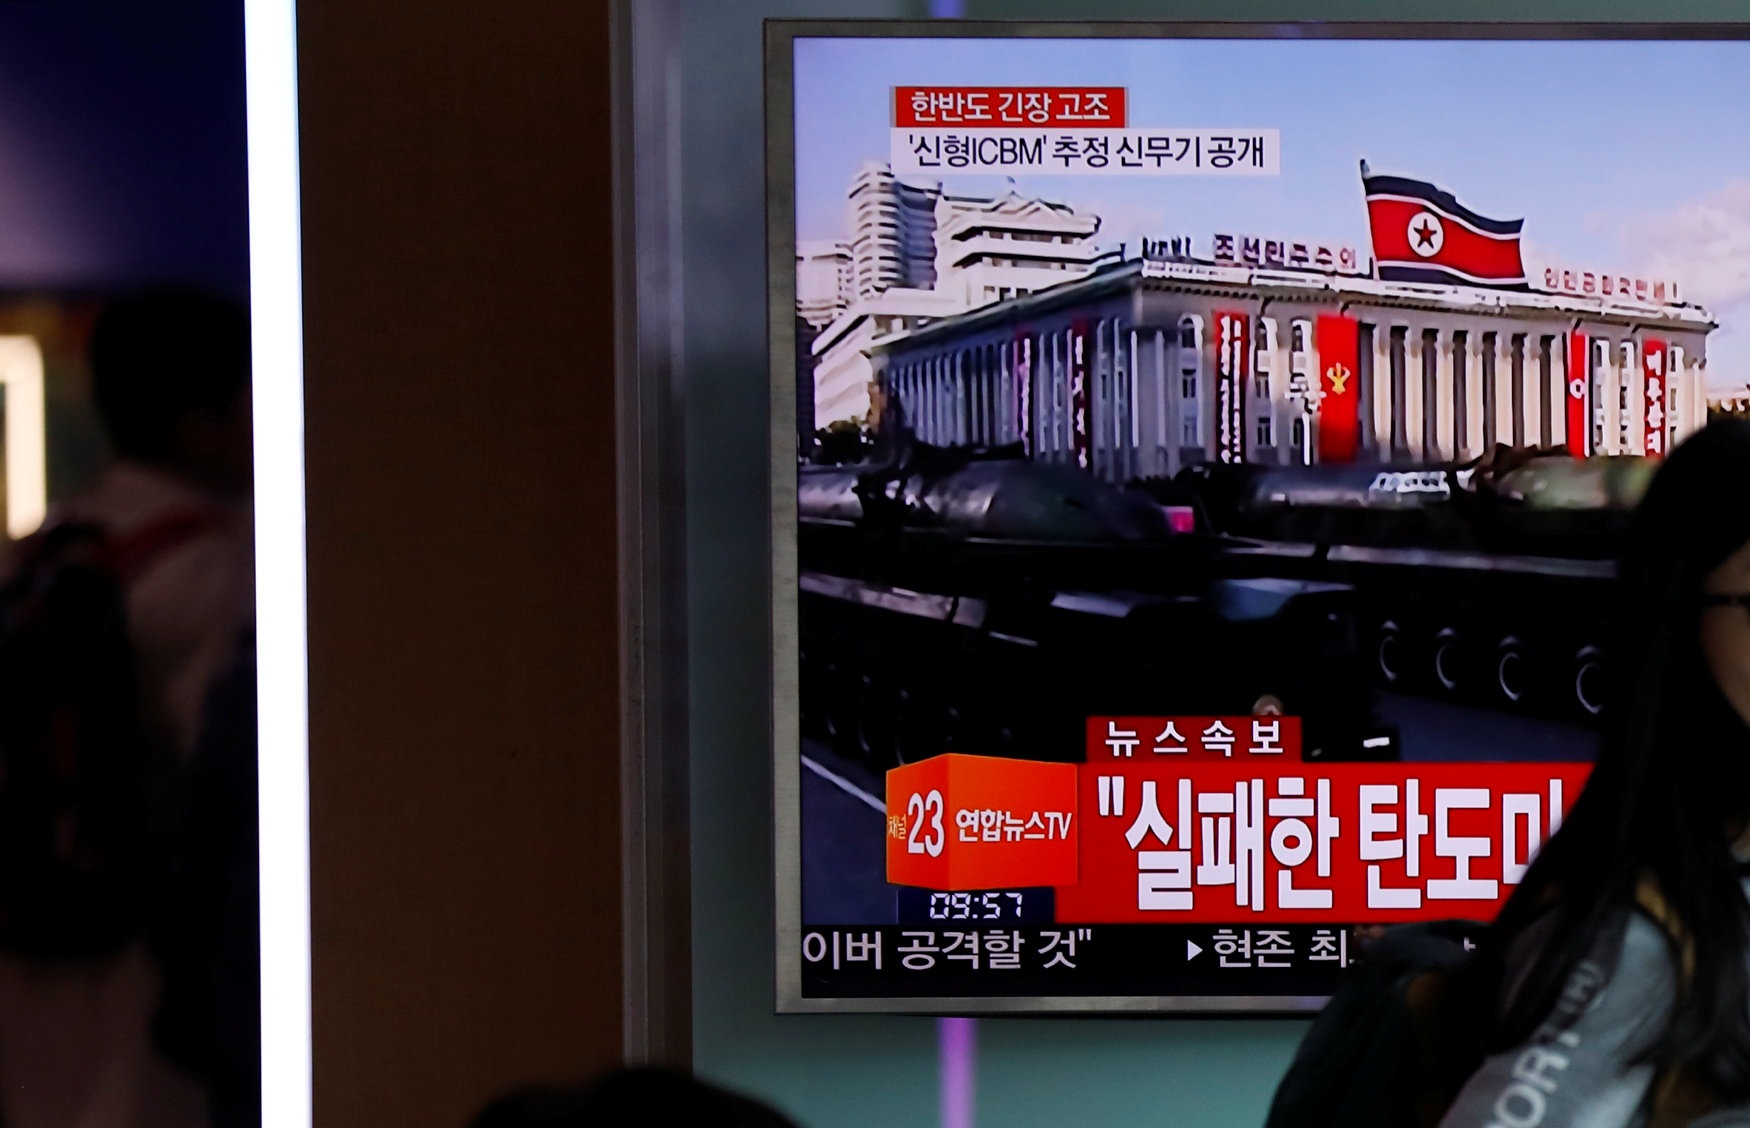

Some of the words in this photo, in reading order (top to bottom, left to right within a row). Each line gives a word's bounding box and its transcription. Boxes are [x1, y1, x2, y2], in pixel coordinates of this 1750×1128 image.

[911, 91, 992, 121] 한반도
[998, 92, 1052, 123] 긴장
[1055, 92, 1110, 120] 고조
[909, 134, 1048, 168] '신형ICBM'
[1053, 135, 1108, 168] 추정
[1116, 135, 1200, 168] 신무기
[1207, 135, 1264, 168] 공개
[908, 789, 945, 858] 23
[955, 808, 1073, 843] 연합뉴스TV
[1098, 776, 1340, 912] "실패한
[929, 892, 1023, 919] 09:57
[898, 929, 1026, 970] 공격할
[1038, 928, 1092, 969] 것"
[1212, 929, 1295, 968] 현존
[1309, 929, 1354, 968] 최
